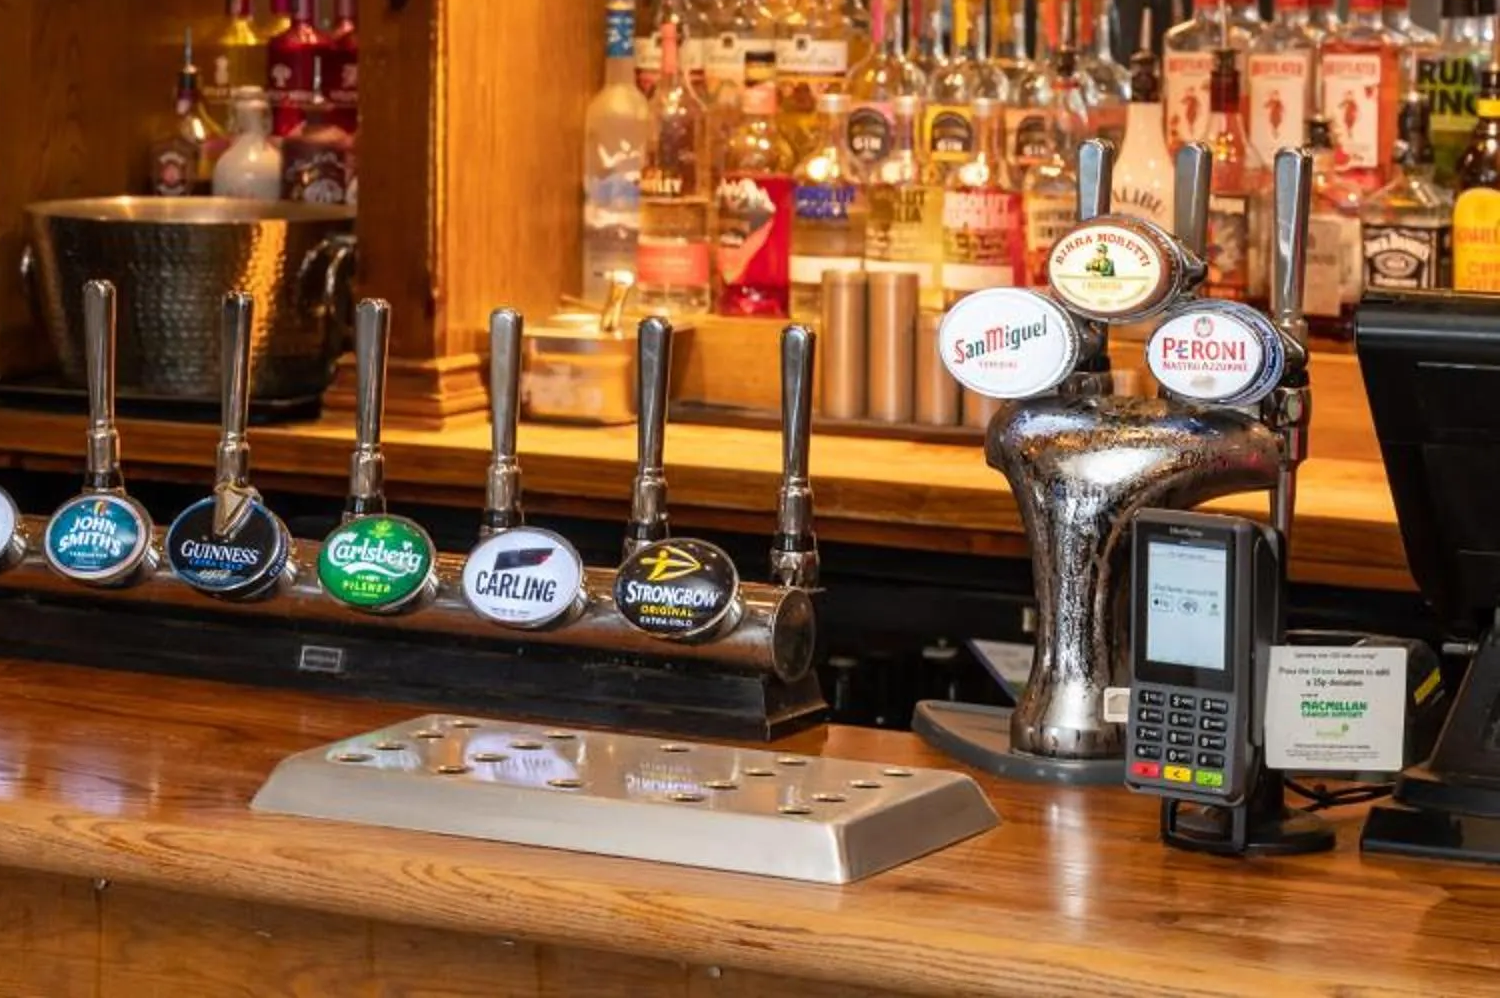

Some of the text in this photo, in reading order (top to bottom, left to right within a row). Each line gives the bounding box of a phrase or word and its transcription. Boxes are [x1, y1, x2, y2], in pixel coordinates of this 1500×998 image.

[1055, 233, 1151, 267] BIRRA MORETTI
[1162, 337, 1246, 361] PERONI
[70, 514, 118, 534] JOHN
[181, 539, 260, 565] GUINNESS
[328, 531, 424, 574] Carlsberg
[341, 580, 392, 594] PILSNER
[475, 569, 558, 603] CARLING
[625, 580, 721, 608] STRONGBOW
[639, 616, 664, 626] EXTRA
[640, 604, 695, 618] ORIGINAL
[1300, 701, 1368, 711] MACMILLAN
